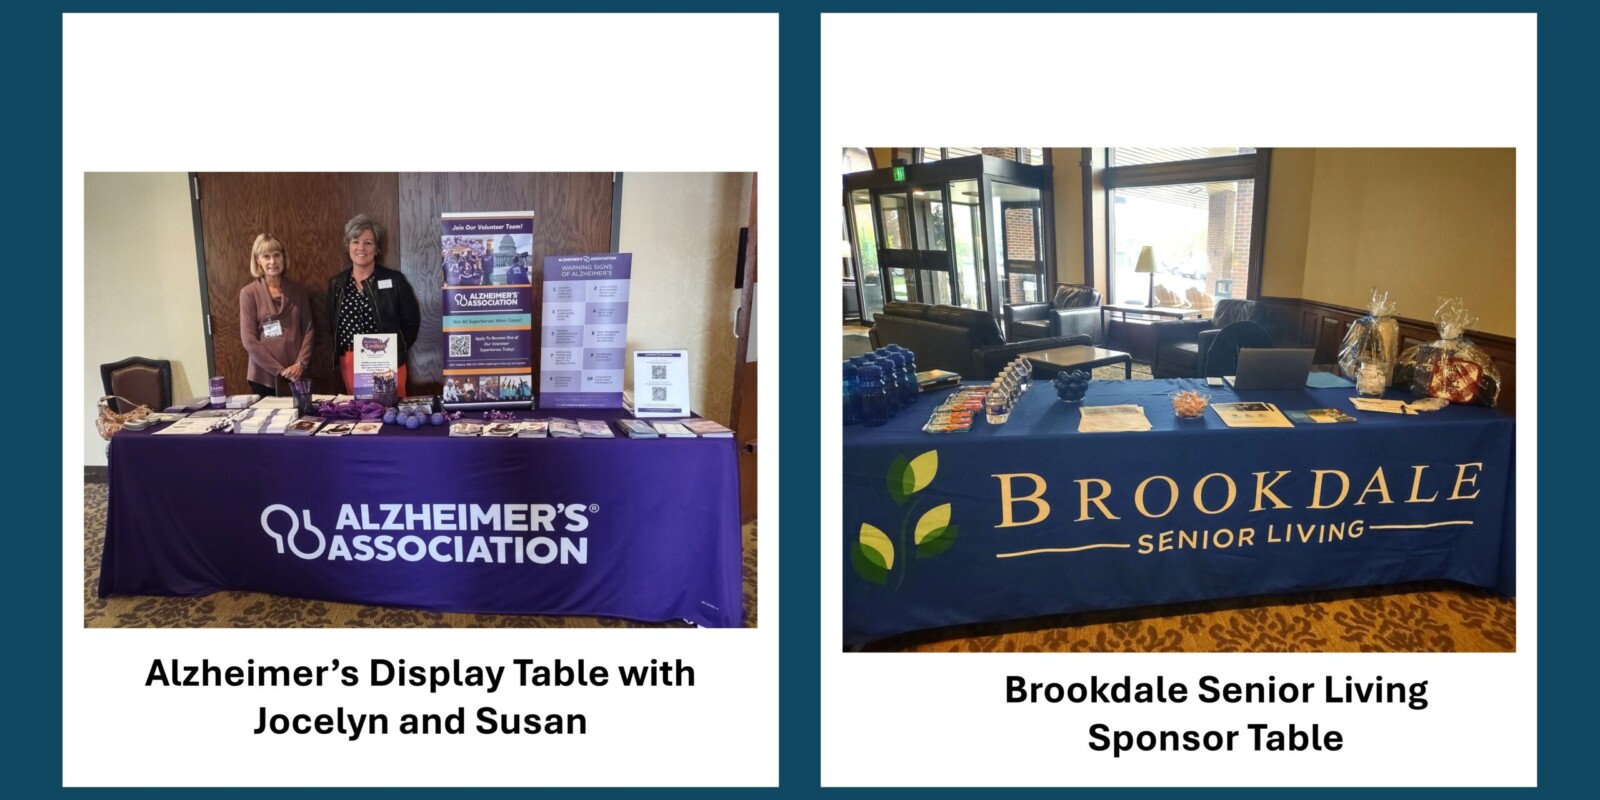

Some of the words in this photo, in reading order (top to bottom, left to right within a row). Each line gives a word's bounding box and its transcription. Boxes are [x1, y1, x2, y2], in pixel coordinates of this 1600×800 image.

[467, 298, 518, 307] ASSOCIATION
[990, 461, 1484, 529] BROOKDALE
[327, 534, 589, 565] ASSOCIATION
[1137, 529, 1256, 556] SENIOR
[1267, 519, 1365, 545] LIVING
